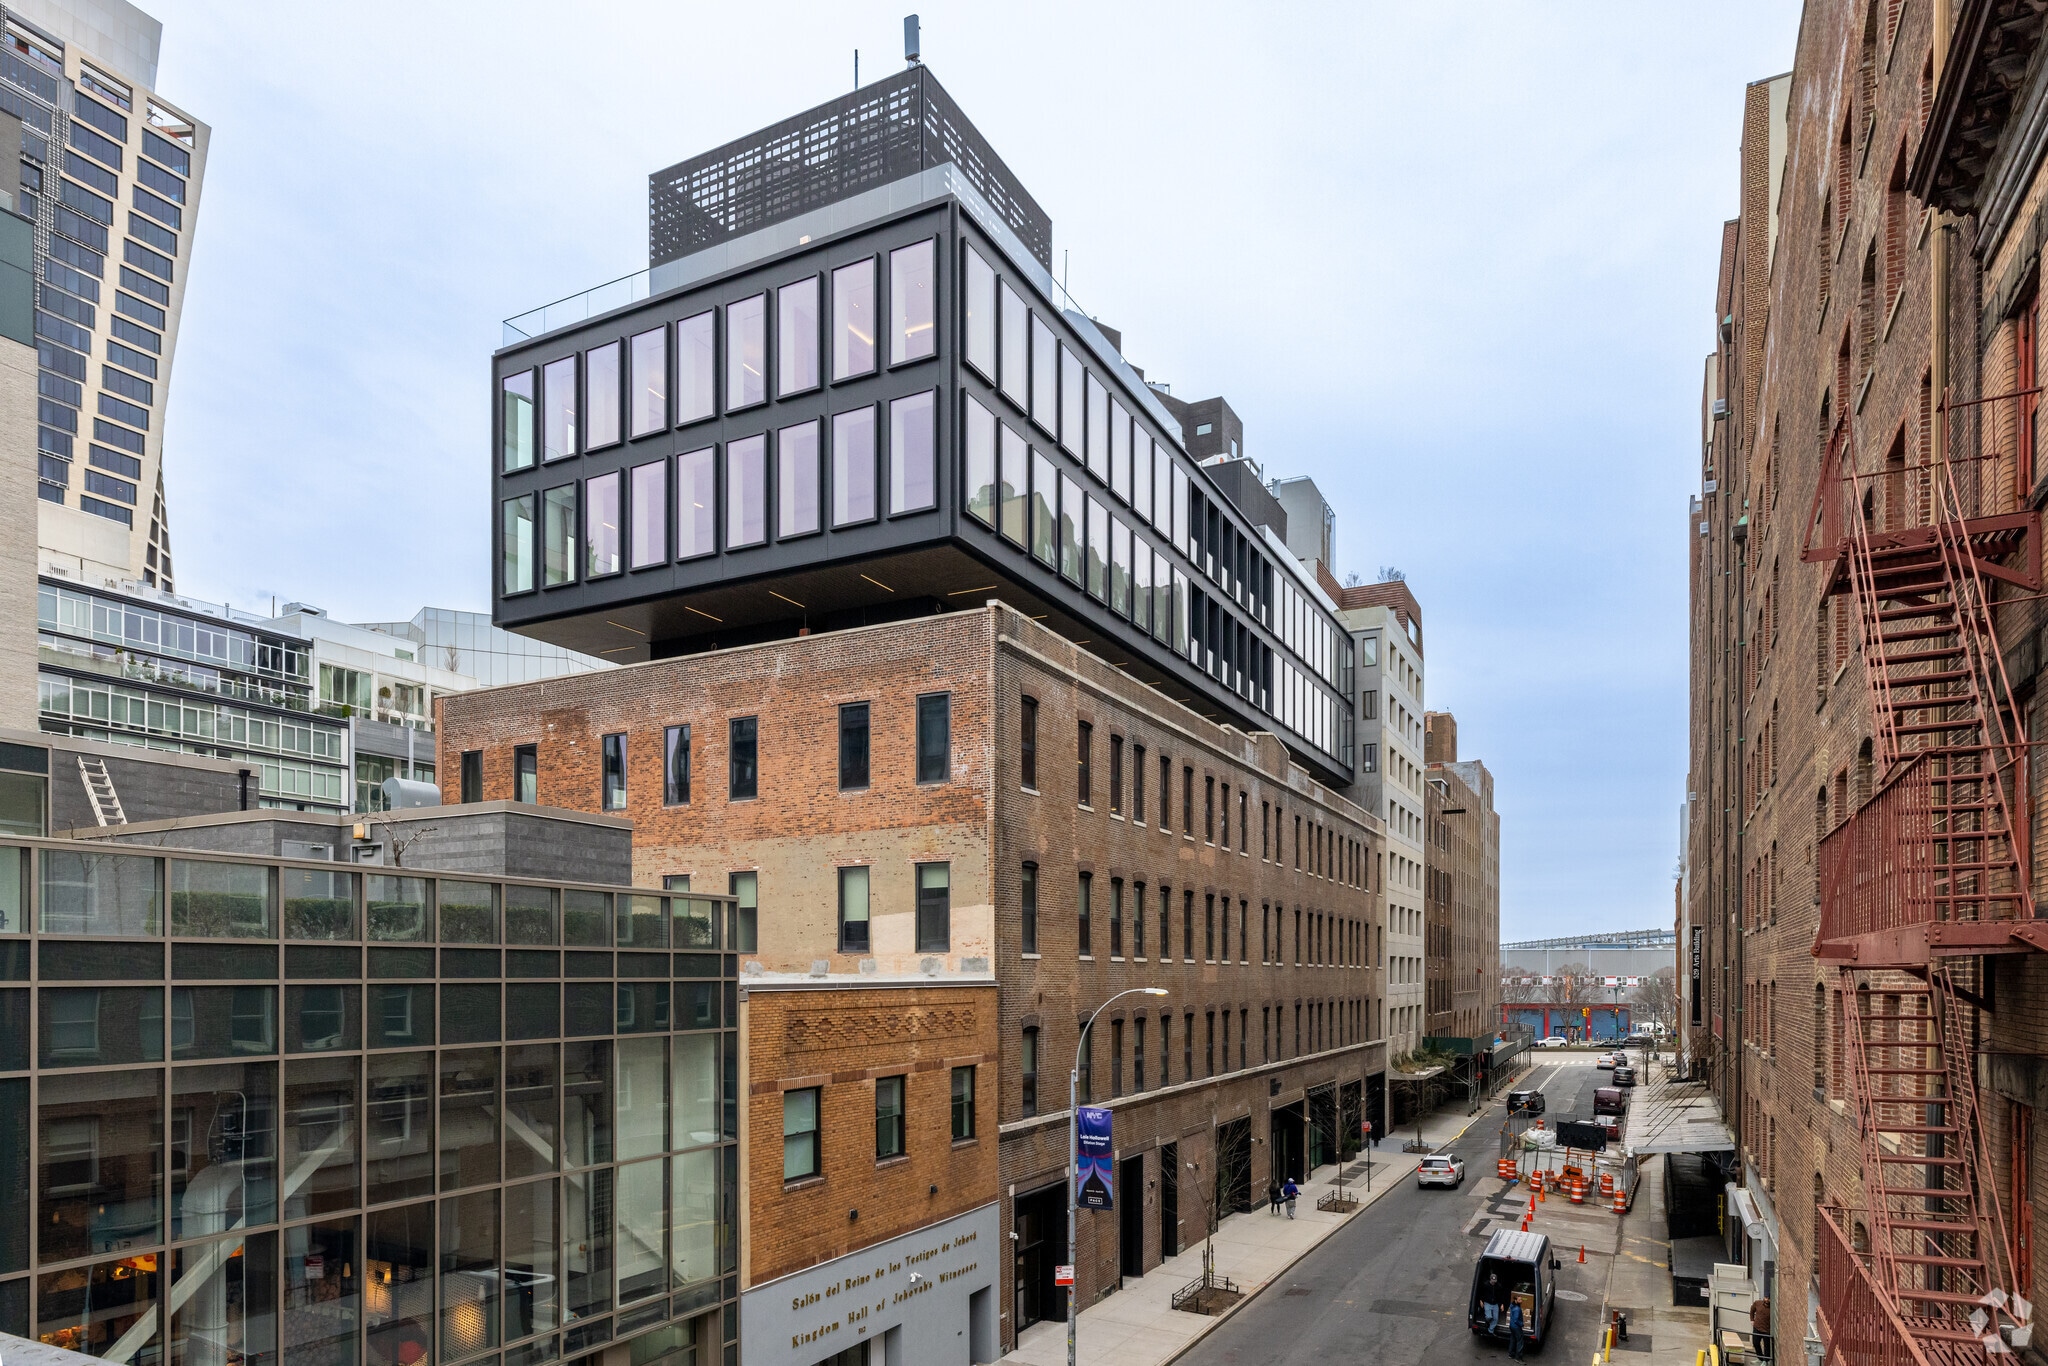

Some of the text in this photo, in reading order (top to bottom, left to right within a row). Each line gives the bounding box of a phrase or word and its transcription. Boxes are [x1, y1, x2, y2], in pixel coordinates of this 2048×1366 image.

[1693, 929, 1701, 953] Building
[1086, 1111, 1103, 1119] NYC
[825, 1282, 840, 1298] del
[845, 1273, 870, 1291] Reino
[875, 1268, 885, 1279] de
[889, 1261, 901, 1274] los
[905, 1247, 938, 1267] Testigos
[941, 1242, 950, 1253] de
[792, 1262, 977, 1349] Kingdom Hall of Jehovah's Witnesses
